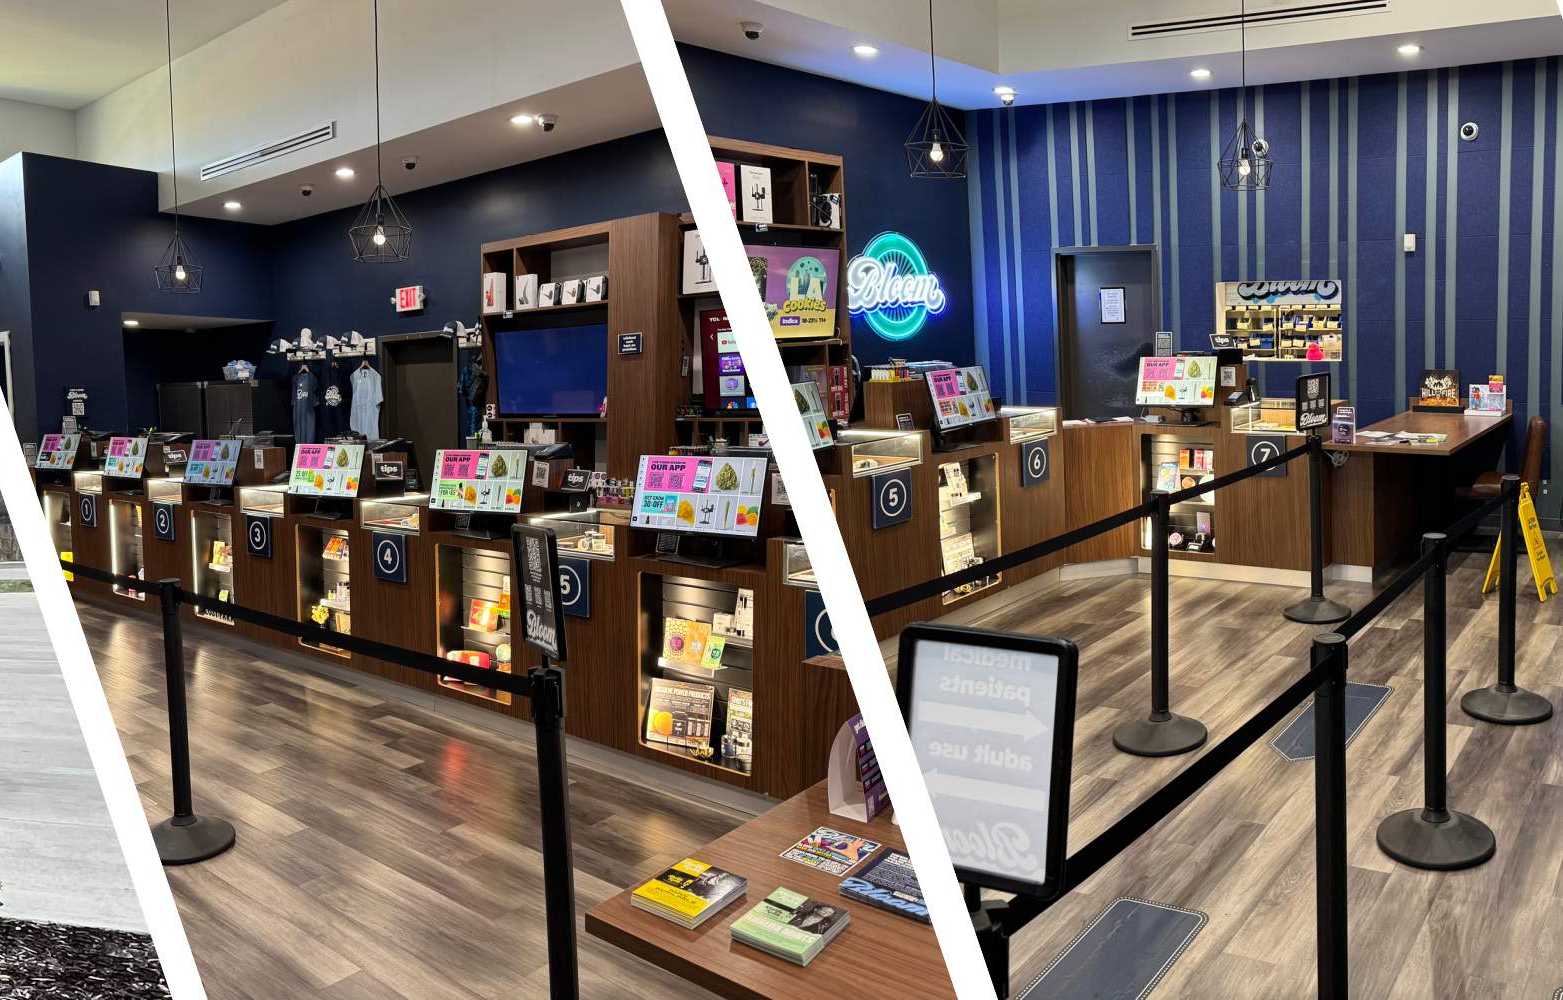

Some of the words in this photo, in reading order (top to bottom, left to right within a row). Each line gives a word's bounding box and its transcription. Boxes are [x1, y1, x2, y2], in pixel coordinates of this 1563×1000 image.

[847, 255, 946, 314] Bloom
[399, 288, 417, 309] EXIT
[783, 297, 827, 314] Cookies
[1215, 336, 1229, 344] tips
[1422, 388, 1436, 398] HILL
[1442, 388, 1456, 399] FIRE
[1300, 412, 1327, 427] Bloom
[380, 464, 398, 473] tips
[1033, 454, 1041, 470] 6
[567, 473, 584, 484] tips
[889, 488, 898, 507] 5
[254, 529, 261, 542] 3
[384, 548, 392, 564] 4
[560, 575, 571, 595] 5
[526, 608, 558, 651] Bloom
